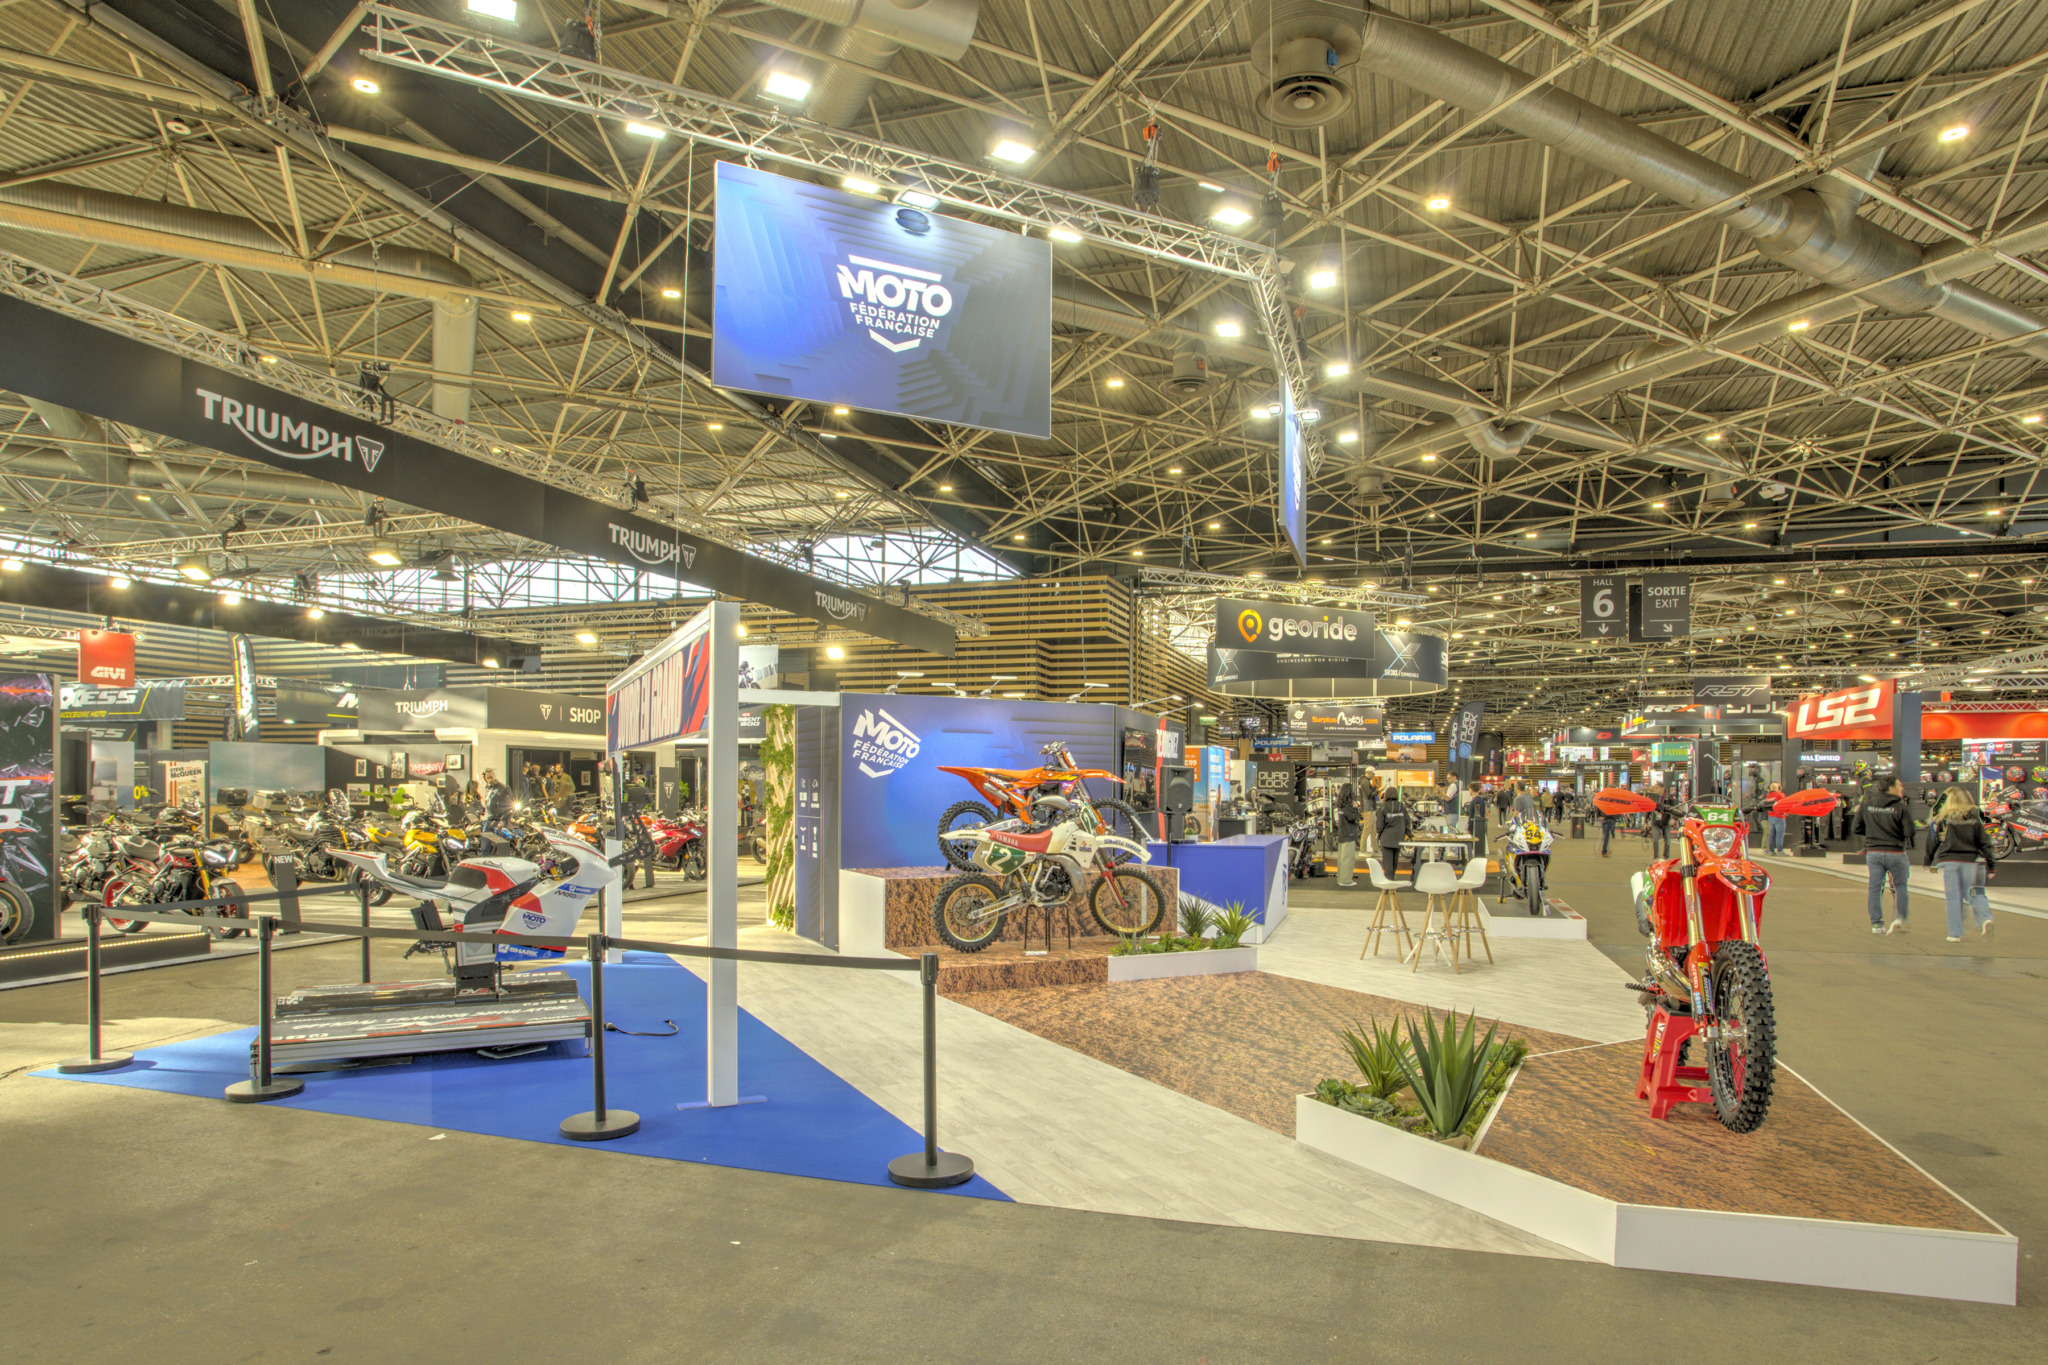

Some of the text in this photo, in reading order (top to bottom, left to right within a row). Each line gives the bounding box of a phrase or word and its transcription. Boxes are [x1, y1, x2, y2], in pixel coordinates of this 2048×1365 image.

[836, 264, 953, 317] MOTO
[849, 302, 940, 330] FÉDÉRATION
[855, 314, 935, 338] FRANÇAISE
[196, 388, 352, 462] TRIUMPH
[608, 523, 681, 564] TRIUMPH
[1648, 586, 1687, 596] SORTIE
[815, 591, 858, 620] TRIUMPH
[1593, 589, 1615, 618] 6
[1655, 599, 1679, 608] EXIT
[1268, 615, 1358, 642] georide
[91, 666, 126, 680] GIVI
[1696, 685, 1769, 697] RST
[395, 700, 448, 718] TRIUMPH
[570, 707, 601, 724] SHOP
[1796, 688, 1881, 733] LS2
[852, 709, 920, 759] MOTO
[852, 749, 905, 768] FRANÇAISE
[853, 739, 909, 764] FÉDÉRATION
[170, 769, 201, 778] McQUEEN
[1258, 780, 1289, 788] LOCK
[1707, 812, 1730, 821] 64
[996, 834, 1019, 847] YAMAHA
[1525, 829, 1542, 840] 94
[274, 855, 293, 864] NEW
[991, 848, 1012, 873] 2
[523, 912, 546, 924] MOTO
[508, 946, 539, 957] SHARK
